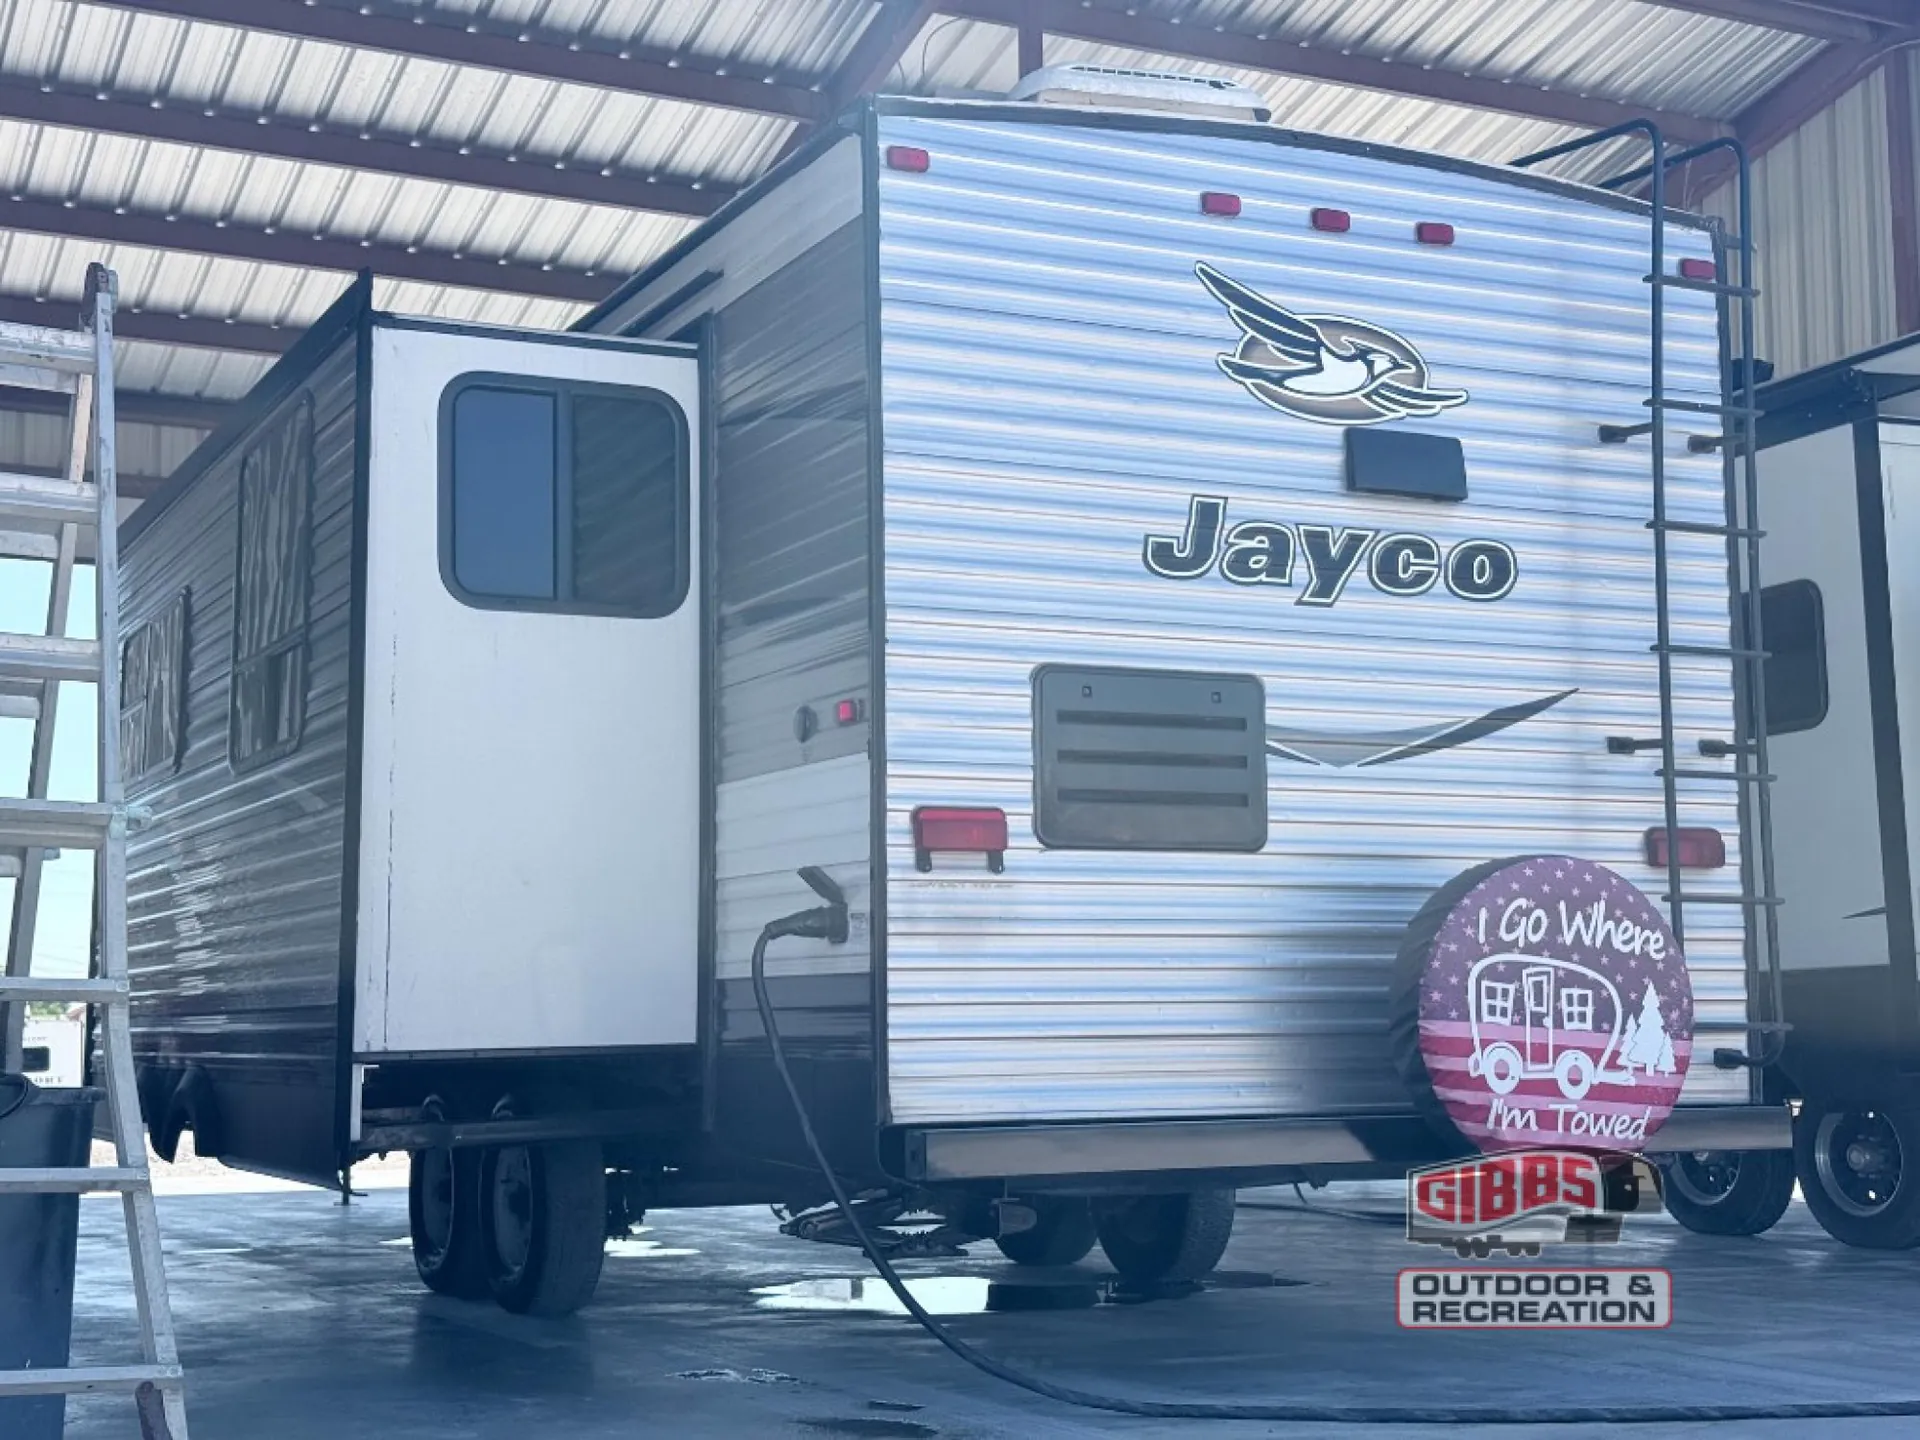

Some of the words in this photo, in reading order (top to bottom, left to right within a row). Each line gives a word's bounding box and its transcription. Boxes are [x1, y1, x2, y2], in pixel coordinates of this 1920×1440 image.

[1142, 494, 1519, 607] Jayco
[1477, 906, 1487, 944] I
[1500, 897, 1547, 947] Go
[1559, 899, 1666, 961] Where
[1487, 1098, 1538, 1132] I'm
[1549, 1103, 1651, 1140] Towed
